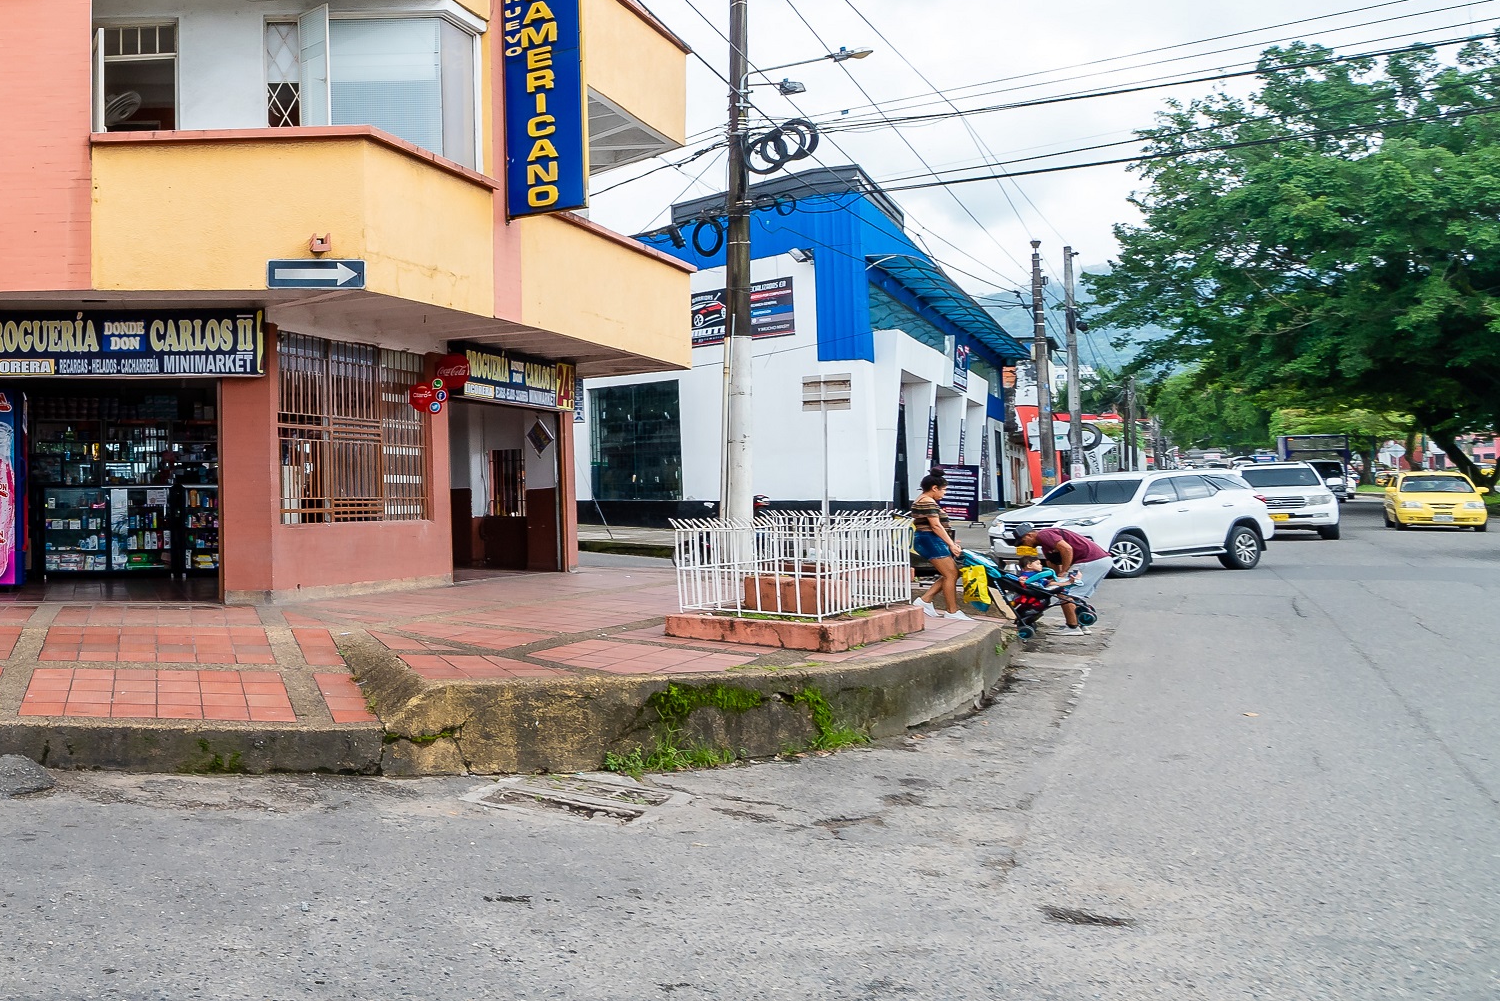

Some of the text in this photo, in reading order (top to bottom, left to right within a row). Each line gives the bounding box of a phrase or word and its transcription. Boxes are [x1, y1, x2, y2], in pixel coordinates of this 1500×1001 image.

[103, 321, 145, 335] DONDE
[150, 319, 234, 352] CARLOS
[110, 336, 141, 351] DON
[59, 359, 88, 374] RECARGAS
[91, 359, 118, 374] HELADOS
[163, 354, 254, 373] MINIMARKET
